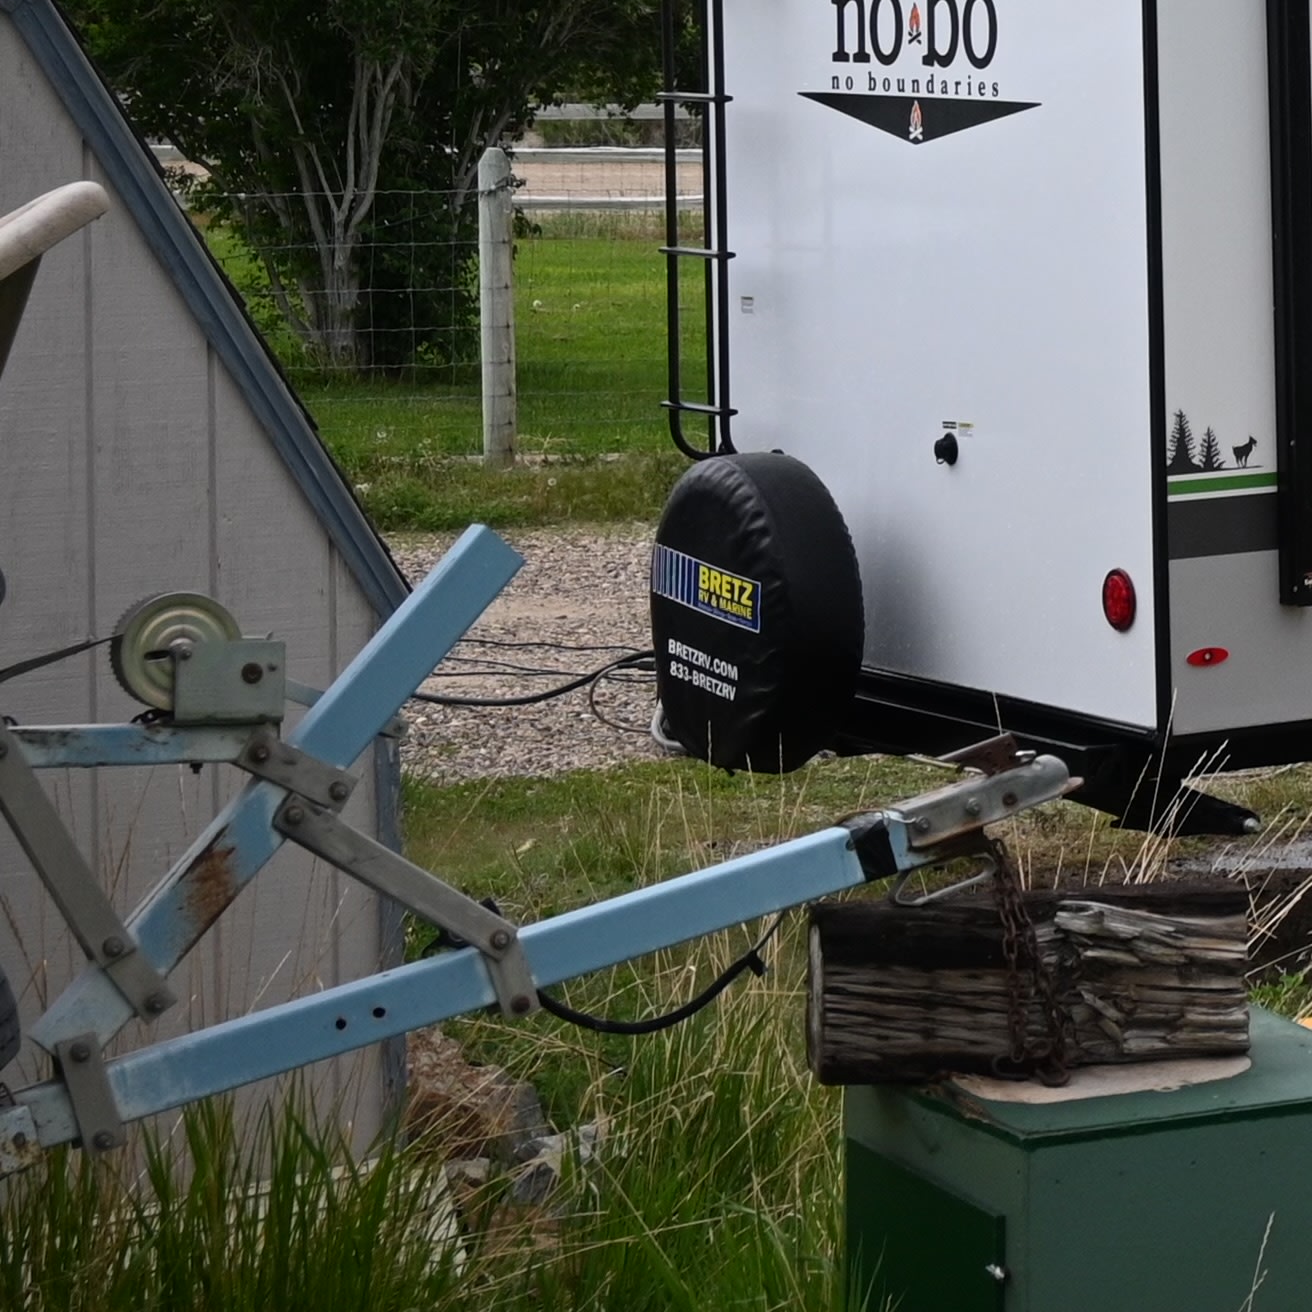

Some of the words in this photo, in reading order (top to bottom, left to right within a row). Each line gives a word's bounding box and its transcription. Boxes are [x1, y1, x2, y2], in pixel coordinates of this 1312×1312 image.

[831, 73, 854, 91] no
[868, 72, 999, 97] boundaries
[699, 564, 753, 607] BRETZ
[699, 588, 709, 604] RV
[710, 594, 718, 608] &
[719, 596, 752, 620] MARINE
[668, 638, 738, 681] BRETZRV.COM
[670, 660, 736, 701] 833-BRETZRV
